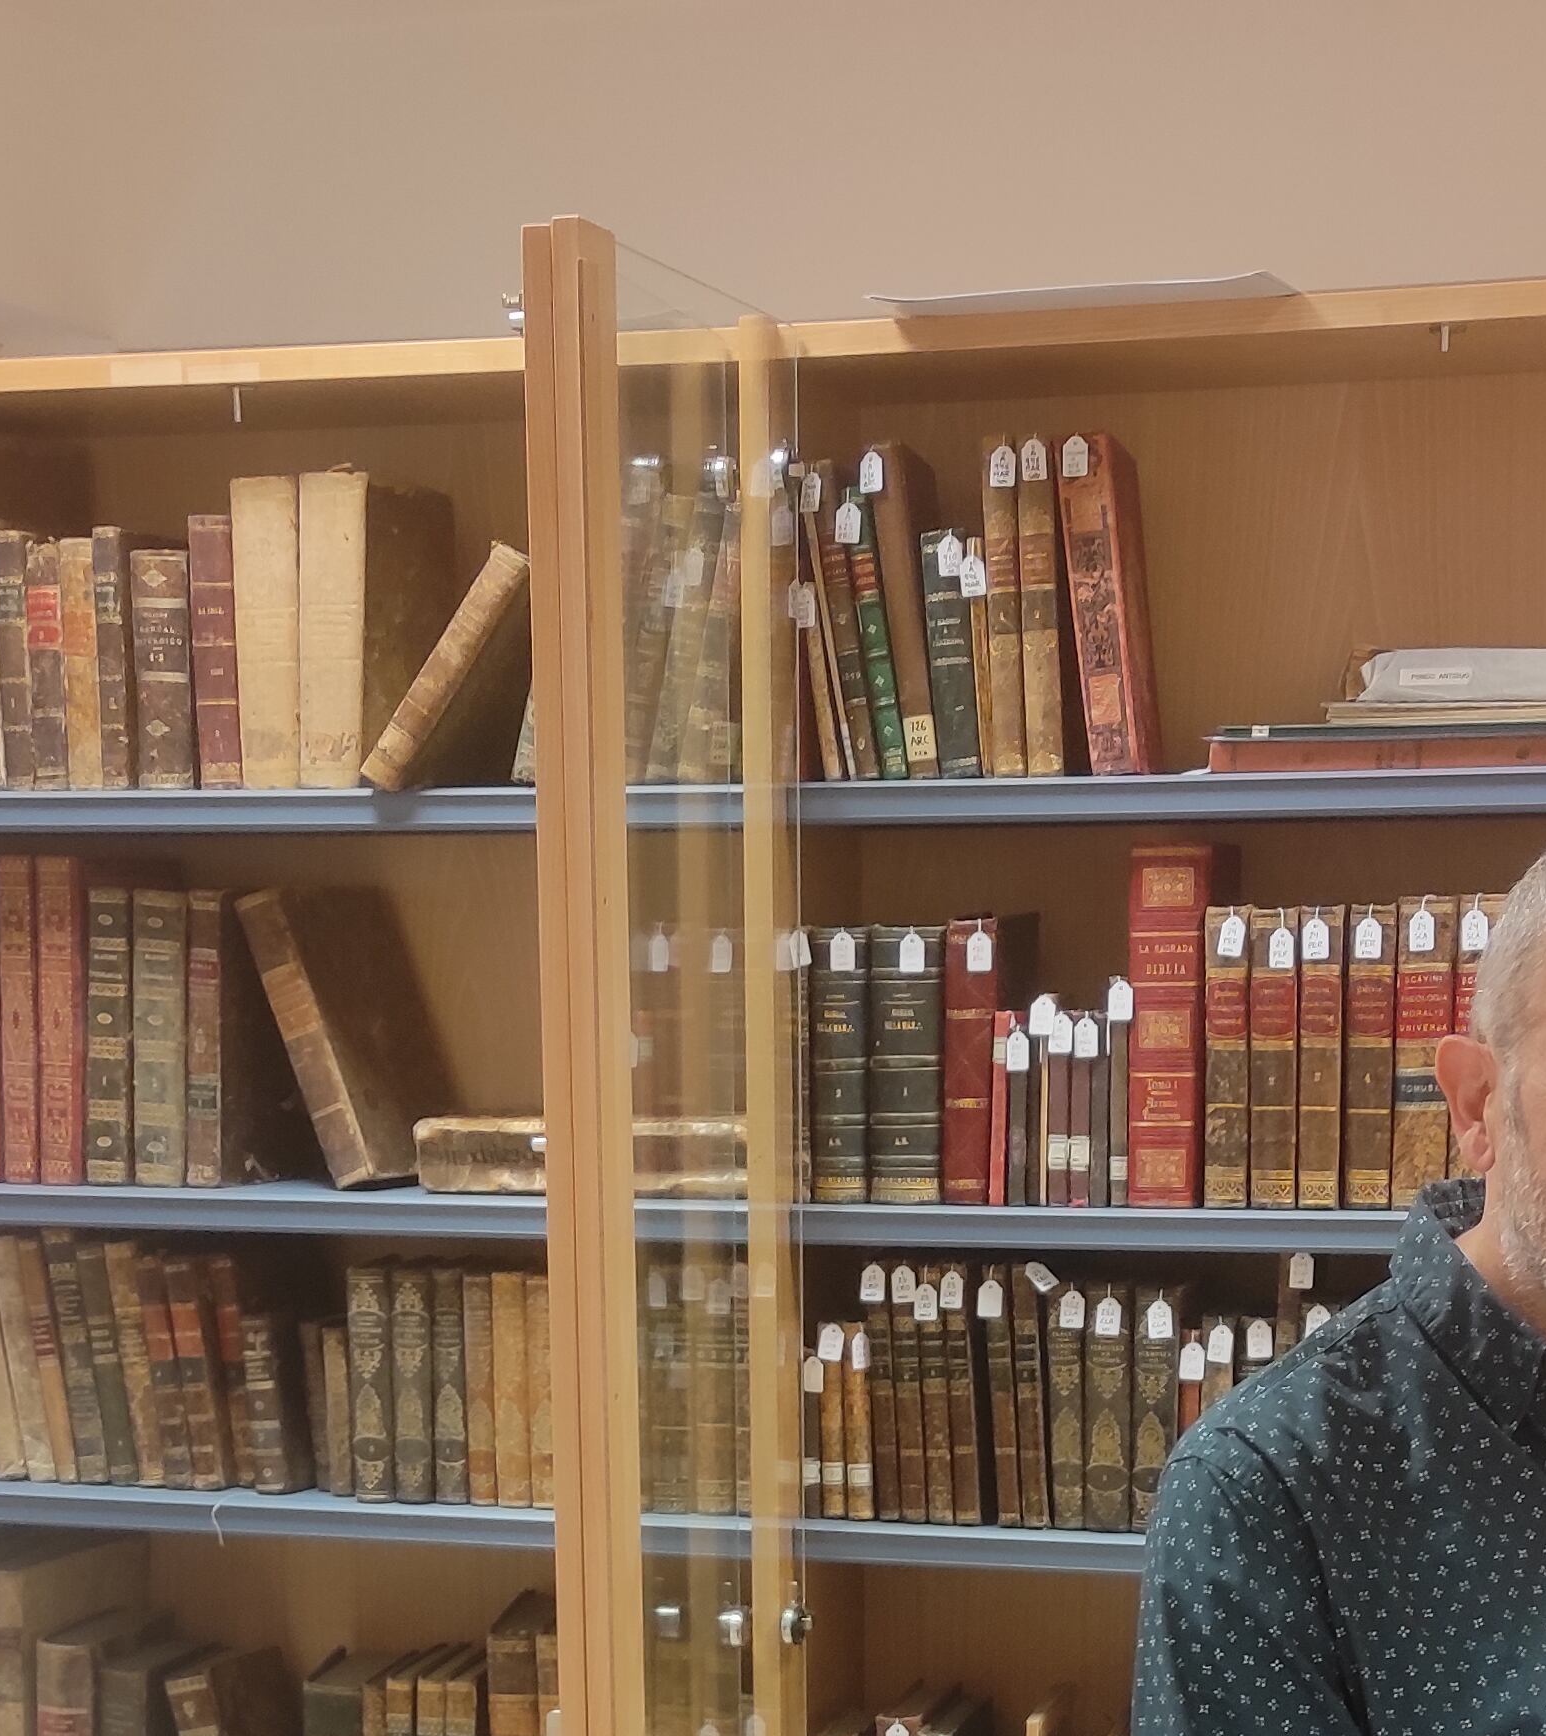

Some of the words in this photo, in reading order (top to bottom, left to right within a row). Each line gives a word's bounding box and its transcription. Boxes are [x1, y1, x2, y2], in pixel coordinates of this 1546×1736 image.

[1138, 943, 1150, 954] LA
[1154, 943, 1195, 954] SAGRADA
[1146, 963, 1187, 975] BIBLIA
